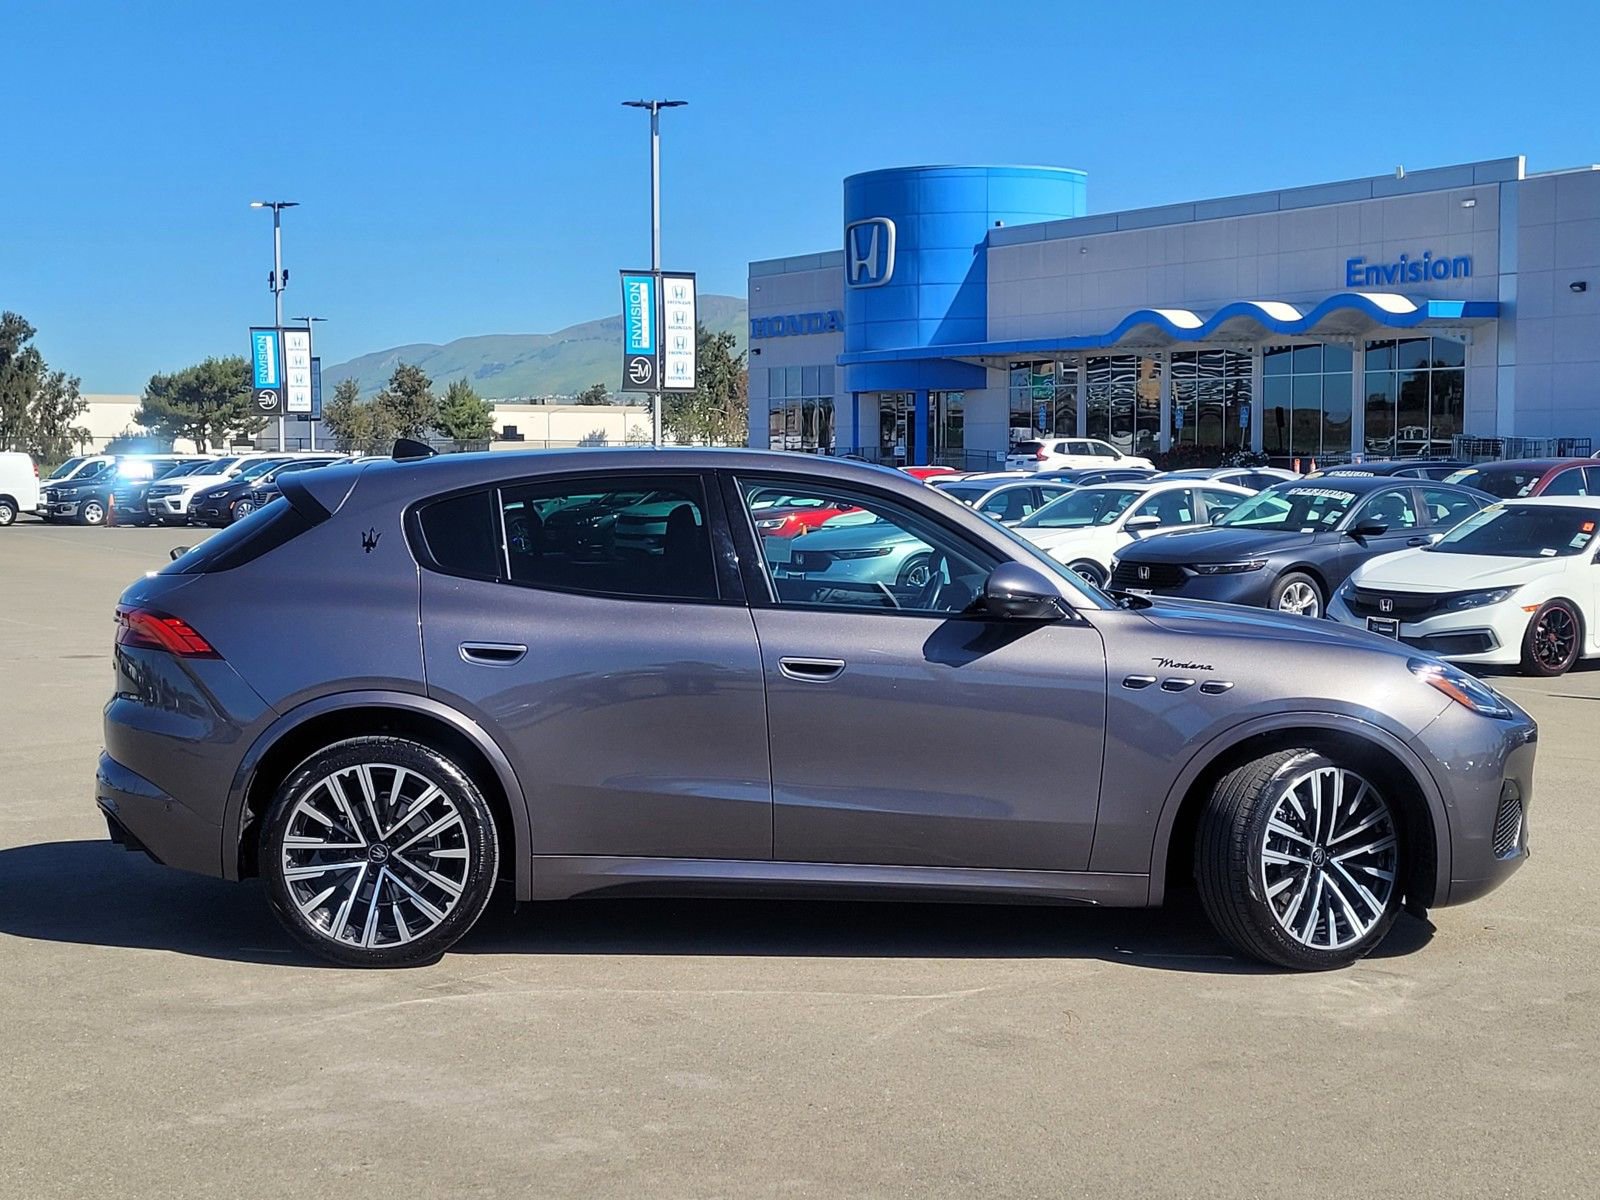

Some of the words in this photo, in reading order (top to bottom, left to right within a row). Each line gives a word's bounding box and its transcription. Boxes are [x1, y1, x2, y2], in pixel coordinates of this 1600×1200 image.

[1346, 251, 1471, 287] Envision
[630, 282, 642, 349] ENVISION
[750, 310, 845, 339] HONDA
[257, 335, 268, 384] ENVISION
[1152, 658, 1214, 671] Modena
